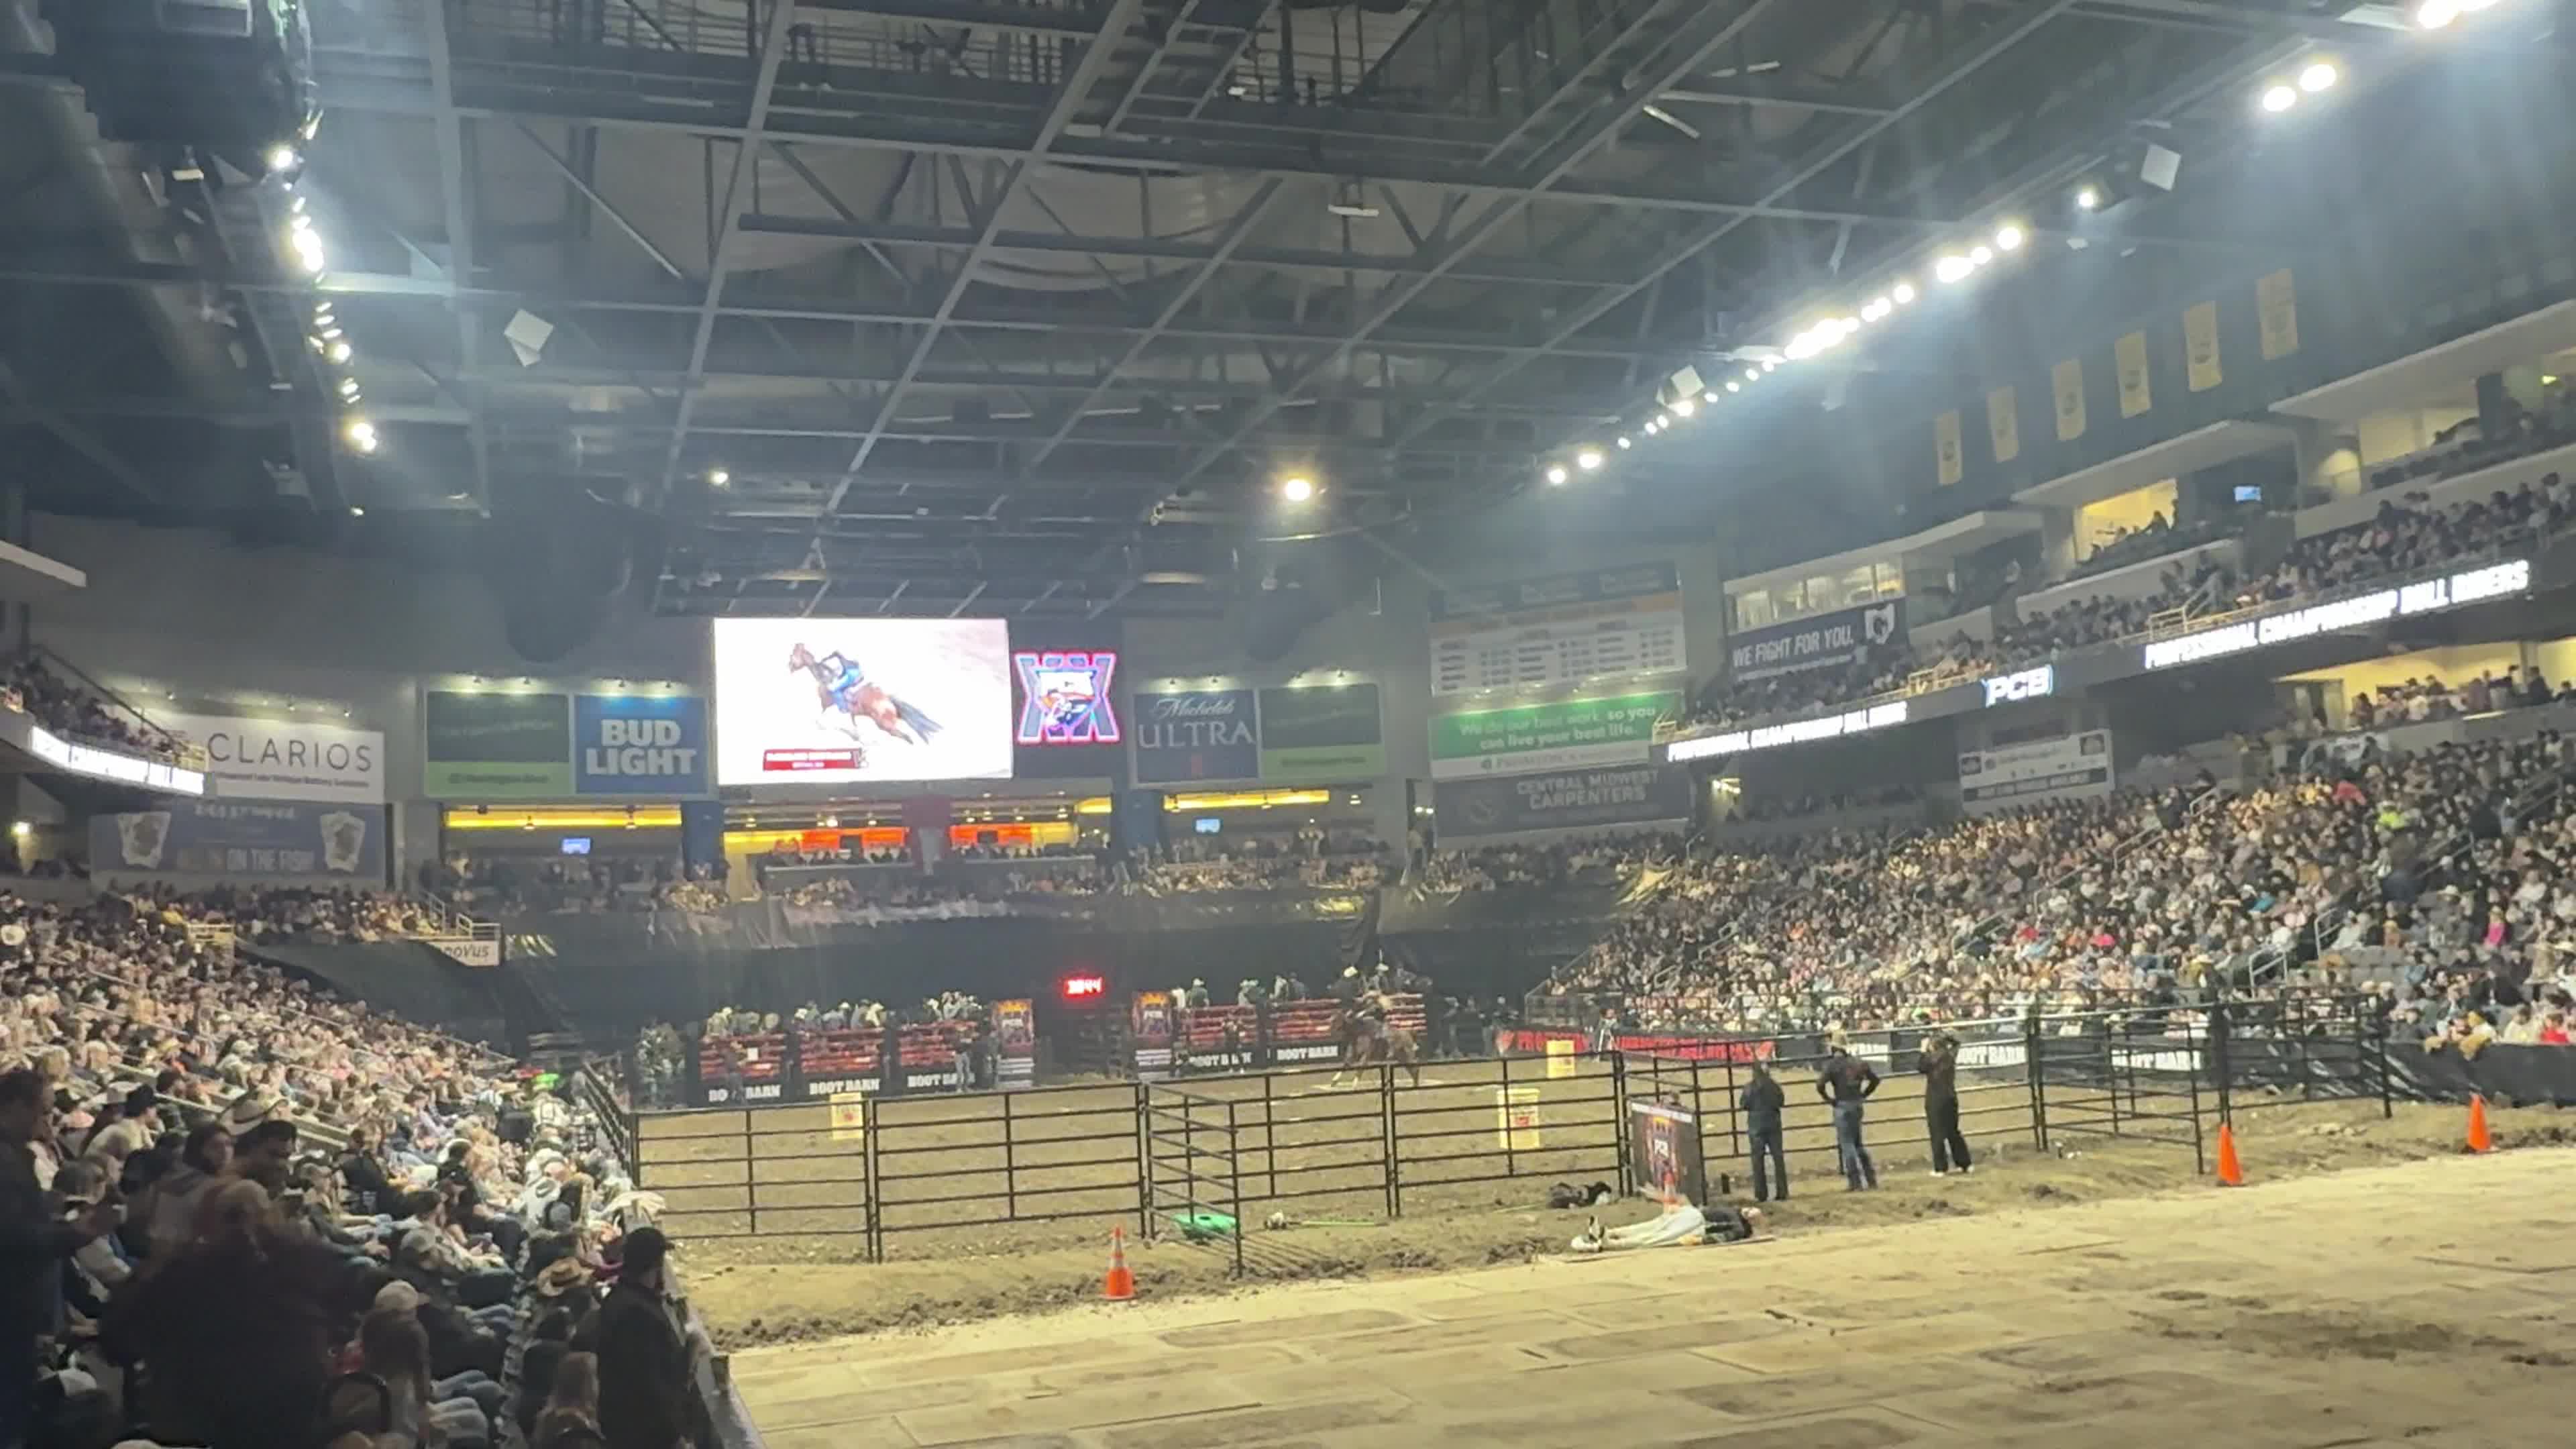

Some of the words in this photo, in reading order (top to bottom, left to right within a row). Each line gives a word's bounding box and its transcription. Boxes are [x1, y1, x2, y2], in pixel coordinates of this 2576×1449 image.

[1733, 645, 1753, 667] WE
[1755, 637, 1792, 665] FIGHT
[1794, 631, 1820, 655] FOR
[1824, 625, 1854, 649] YOU.
[1986, 666, 2051, 706] PCB
[601, 718, 681, 747] BUD
[1138, 721, 1256, 749] ULTRA
[207, 732, 372, 772] CLARIOS
[586, 748, 697, 775] LIGHT
[1517, 775, 1585, 795] CENTRAL
[1529, 784, 1647, 810] CARPENTERS
[1277, 1048, 1307, 1061] BOOT
[1308, 1045, 1338, 1059] BARN
[746, 1084, 782, 1100] BARN
[809, 1081, 844, 1095] BOOT
[845, 1078, 881, 1093] BARN
[908, 1074, 941, 1088] BOOT
